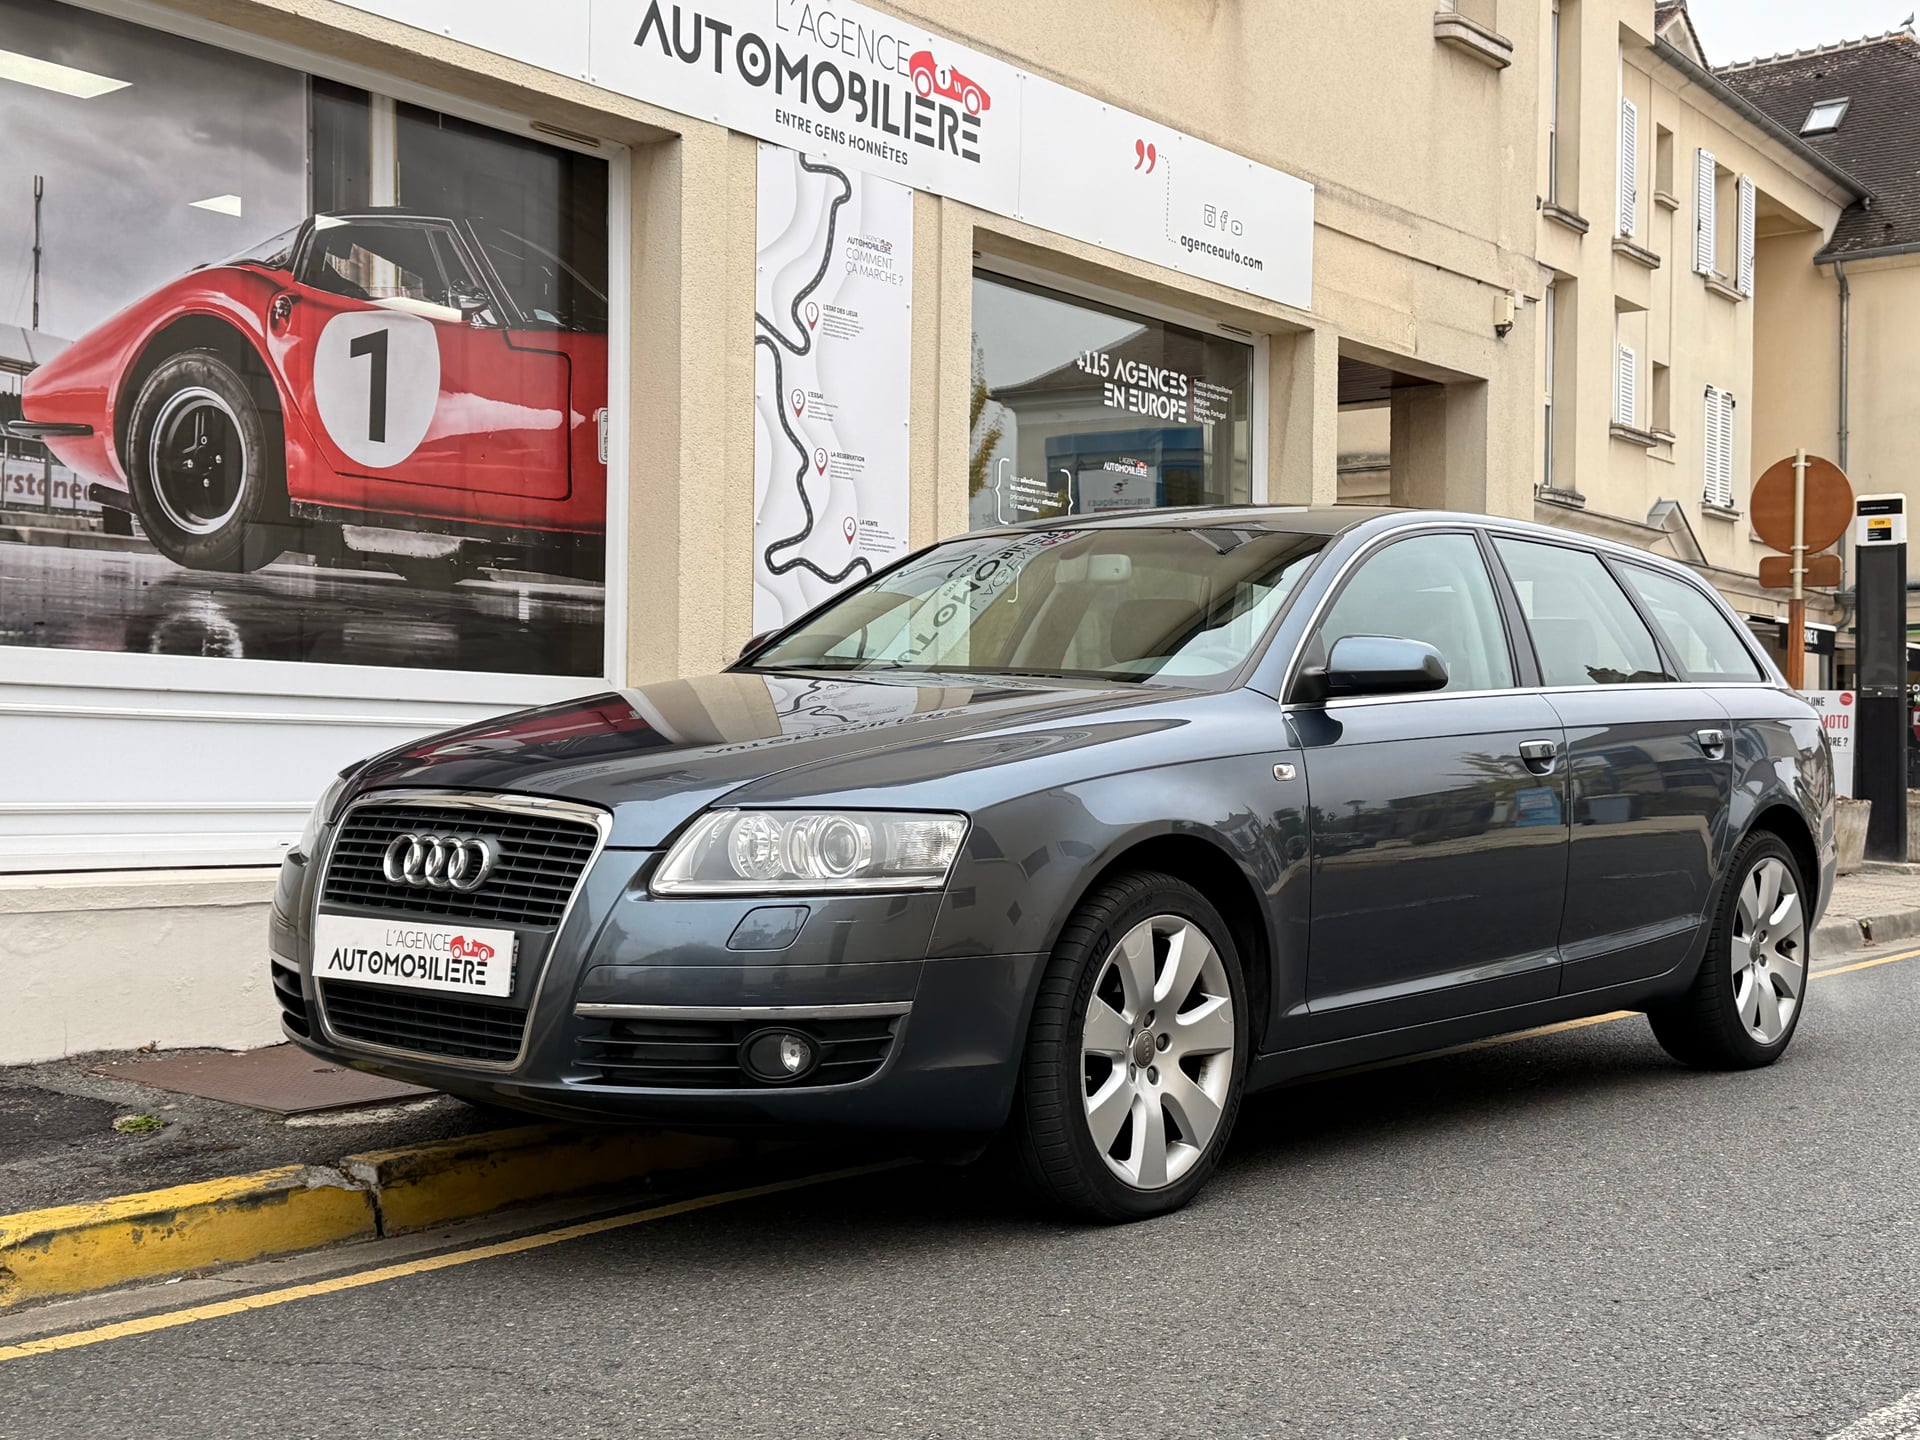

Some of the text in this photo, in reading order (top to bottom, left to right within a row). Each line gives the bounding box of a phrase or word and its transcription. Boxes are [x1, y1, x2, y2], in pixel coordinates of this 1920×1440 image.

[776, 0, 910, 77] L'AGENCE
[775, 109, 909, 165] ENTRE GENS HONNÊTES
[845, 247, 894, 269] COMMENT
[1180, 234, 1263, 271] agenceauto.com
[845, 261, 858, 276] ÇA
[859, 265, 897, 285] MARCHE
[350, 328, 388, 443] 1
[1076, 350, 1188, 397] +115 AGENCES
[796, 393, 802, 404] 2
[1104, 382, 1187, 424] EN EUROPE
[818, 452, 824, 464] 3
[1810, 696, 1825, 707] UNE
[385, 928, 451, 952] L'AGENCE
